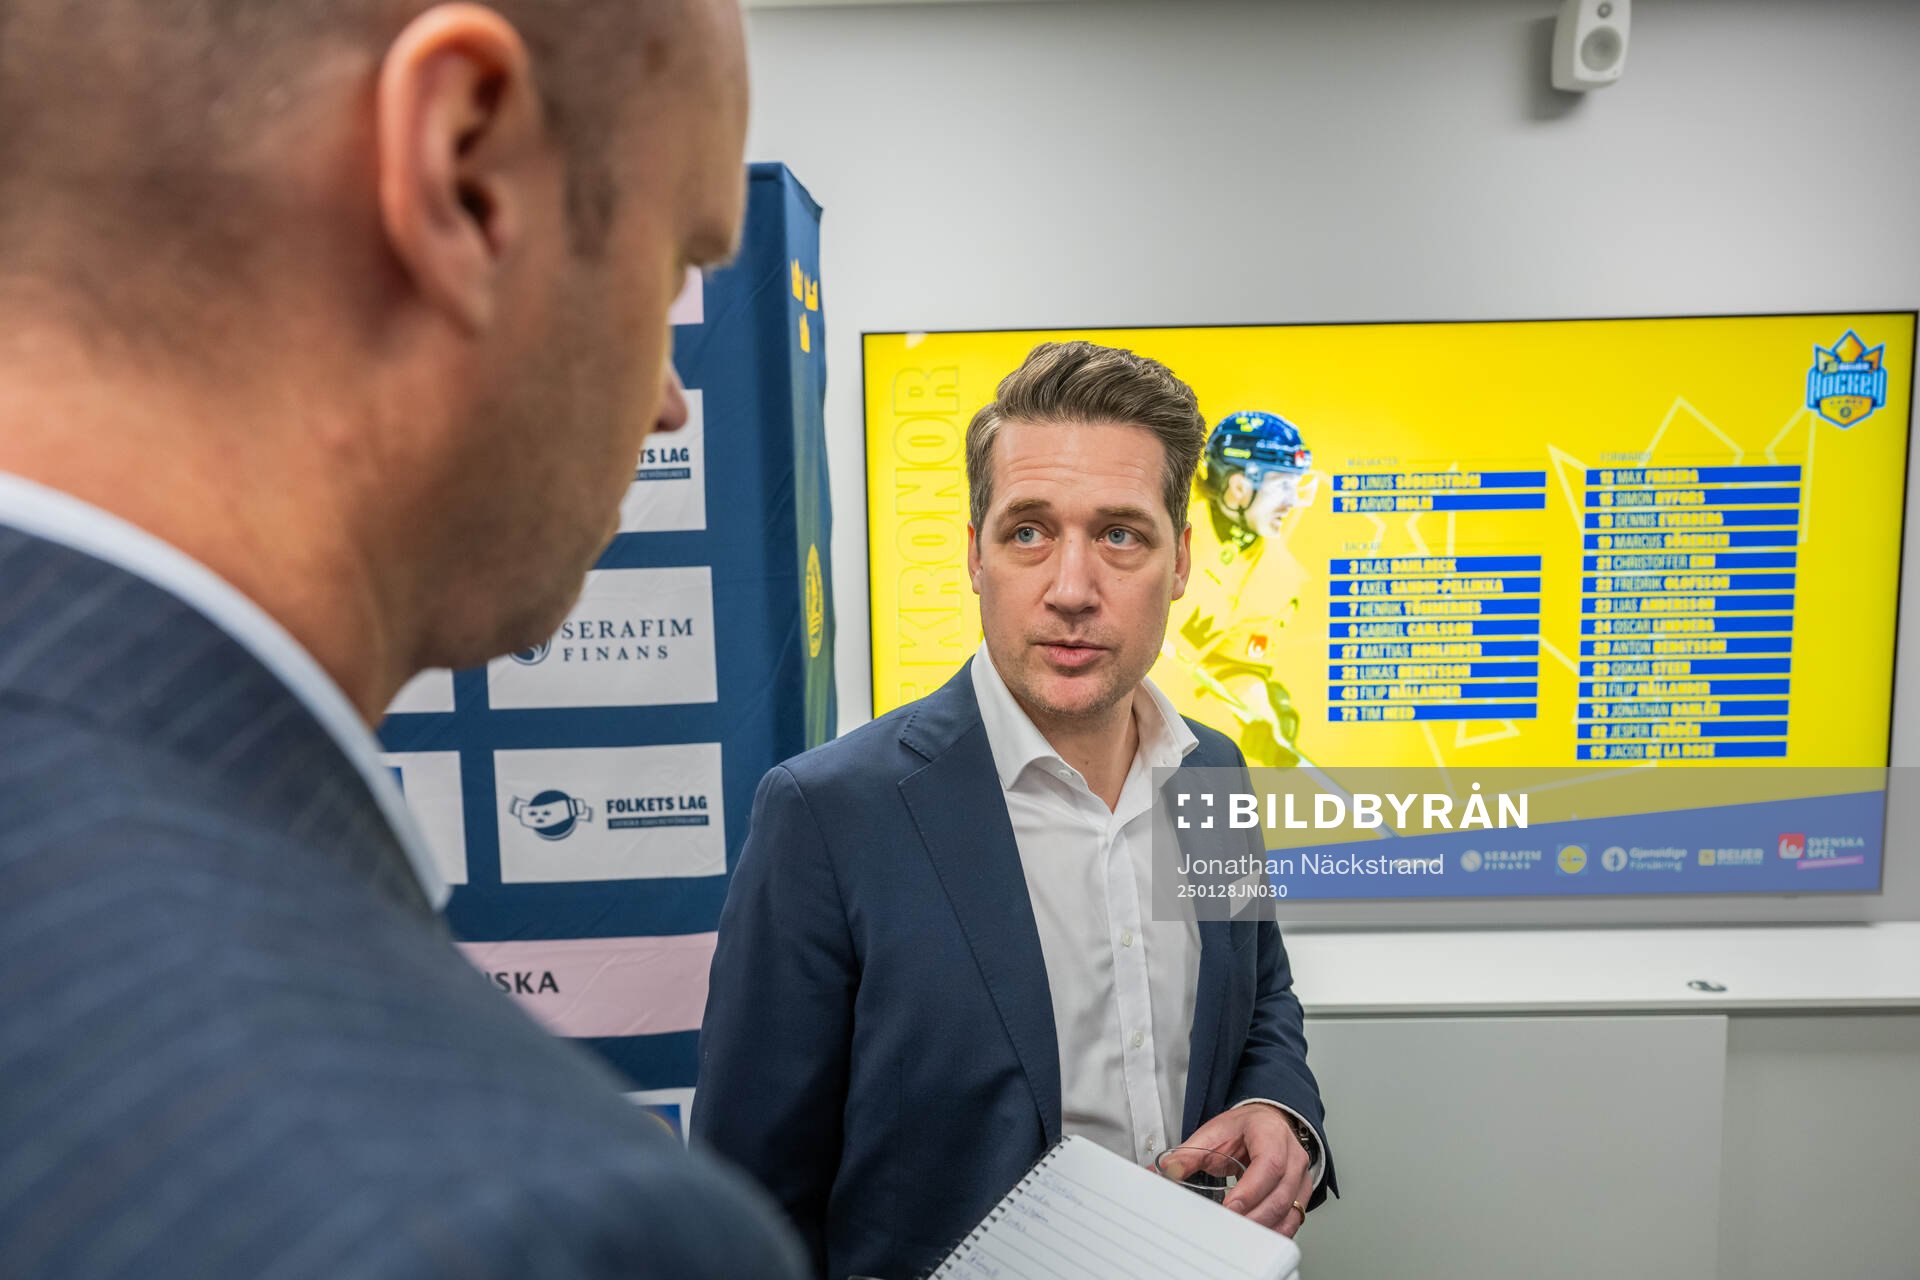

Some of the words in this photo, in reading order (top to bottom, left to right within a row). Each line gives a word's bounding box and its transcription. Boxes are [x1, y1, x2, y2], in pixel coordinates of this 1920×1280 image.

[661, 447, 690, 463] LAG
[1361, 475, 1393, 489] LINUS
[1616, 470, 1643, 484] MAX
[1359, 496, 1394, 511] ARVID
[1615, 492, 1654, 505] SIMON
[894, 366, 960, 666] KRONOR
[1615, 513, 1656, 527] DENNIS
[1614, 534, 1662, 548] MARCUS
[1349, 560, 1358, 574] 3
[1359, 559, 1389, 574] KLAS
[1613, 555, 1688, 570] CHRISTOFFER
[1348, 580, 1359, 595] 4
[1360, 580, 1388, 595] AXEL
[1614, 577, 1662, 591] FREDRIK
[1348, 602, 1358, 616] 7
[1360, 602, 1402, 616] HENRIK
[1613, 598, 1638, 612] LIAS
[561, 618, 694, 640] SERAFIM
[1359, 623, 1403, 637] GABRIEL
[1613, 619, 1651, 633] OSCAR
[562, 646, 669, 662] FINANS
[1361, 644, 1409, 658] MATTIAS
[1612, 641, 1651, 655] ANTON
[1360, 665, 1396, 679] LUKAS
[1611, 661, 1650, 676] OSKAR
[1360, 685, 1387, 700] FILIP
[1608, 682, 1636, 697] FILIP
[1361, 706, 1381, 720] TIM
[1611, 703, 1669, 718] JONATHAN
[1610, 723, 1650, 738] JESPER
[1609, 745, 1645, 759] JACOB
[1664, 744, 1681, 758] LA
[606, 797, 674, 814] FOLKETS
[679, 795, 707, 810] LAG
[484, 971, 560, 994] SKA
